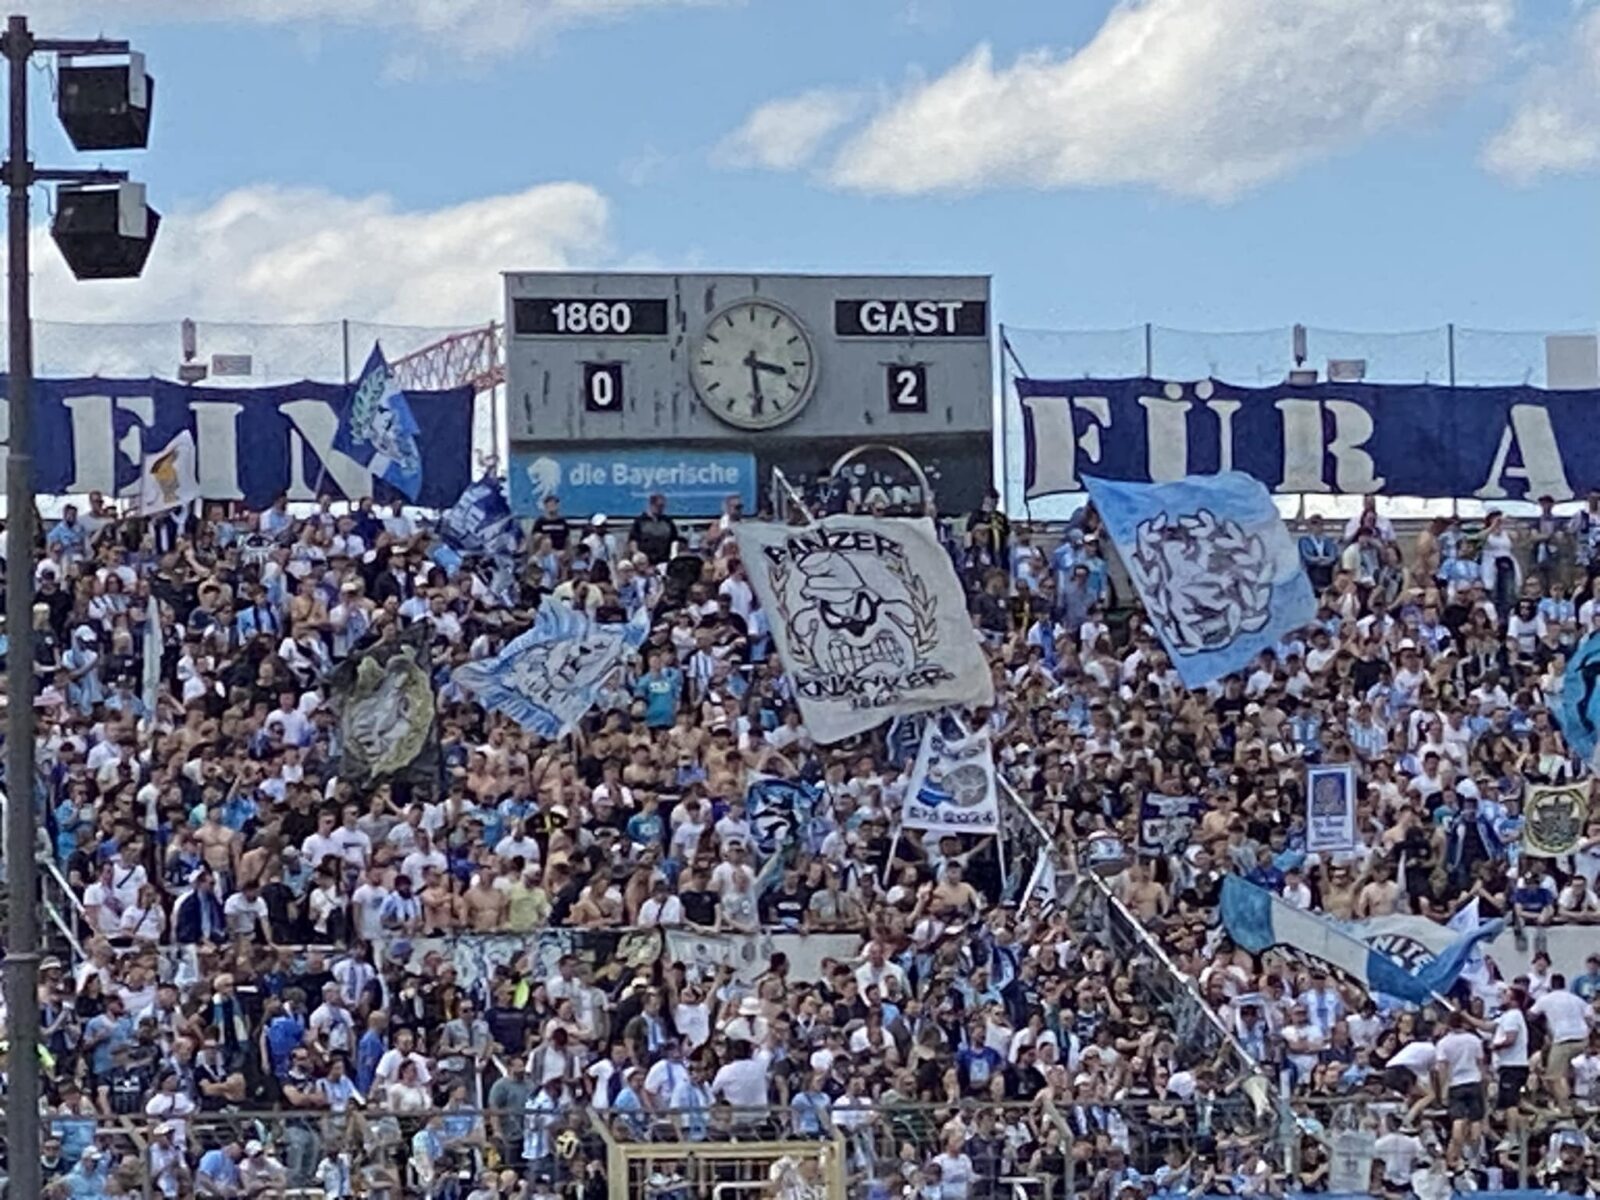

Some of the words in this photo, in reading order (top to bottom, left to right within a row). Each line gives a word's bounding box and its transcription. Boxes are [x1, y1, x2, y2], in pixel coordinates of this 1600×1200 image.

[551, 302, 632, 333] 1860
[860, 300, 963, 333] GAST
[592, 370, 614, 405] 0
[897, 370, 918, 404] 2
[0, 395, 375, 500] EIN
[1022, 379, 1387, 498] FÜR
[569, 463, 606, 486] die
[612, 462, 740, 489] Bayerische
[763, 527, 904, 566] PANZER
[1364, 934, 1437, 978] NITE
